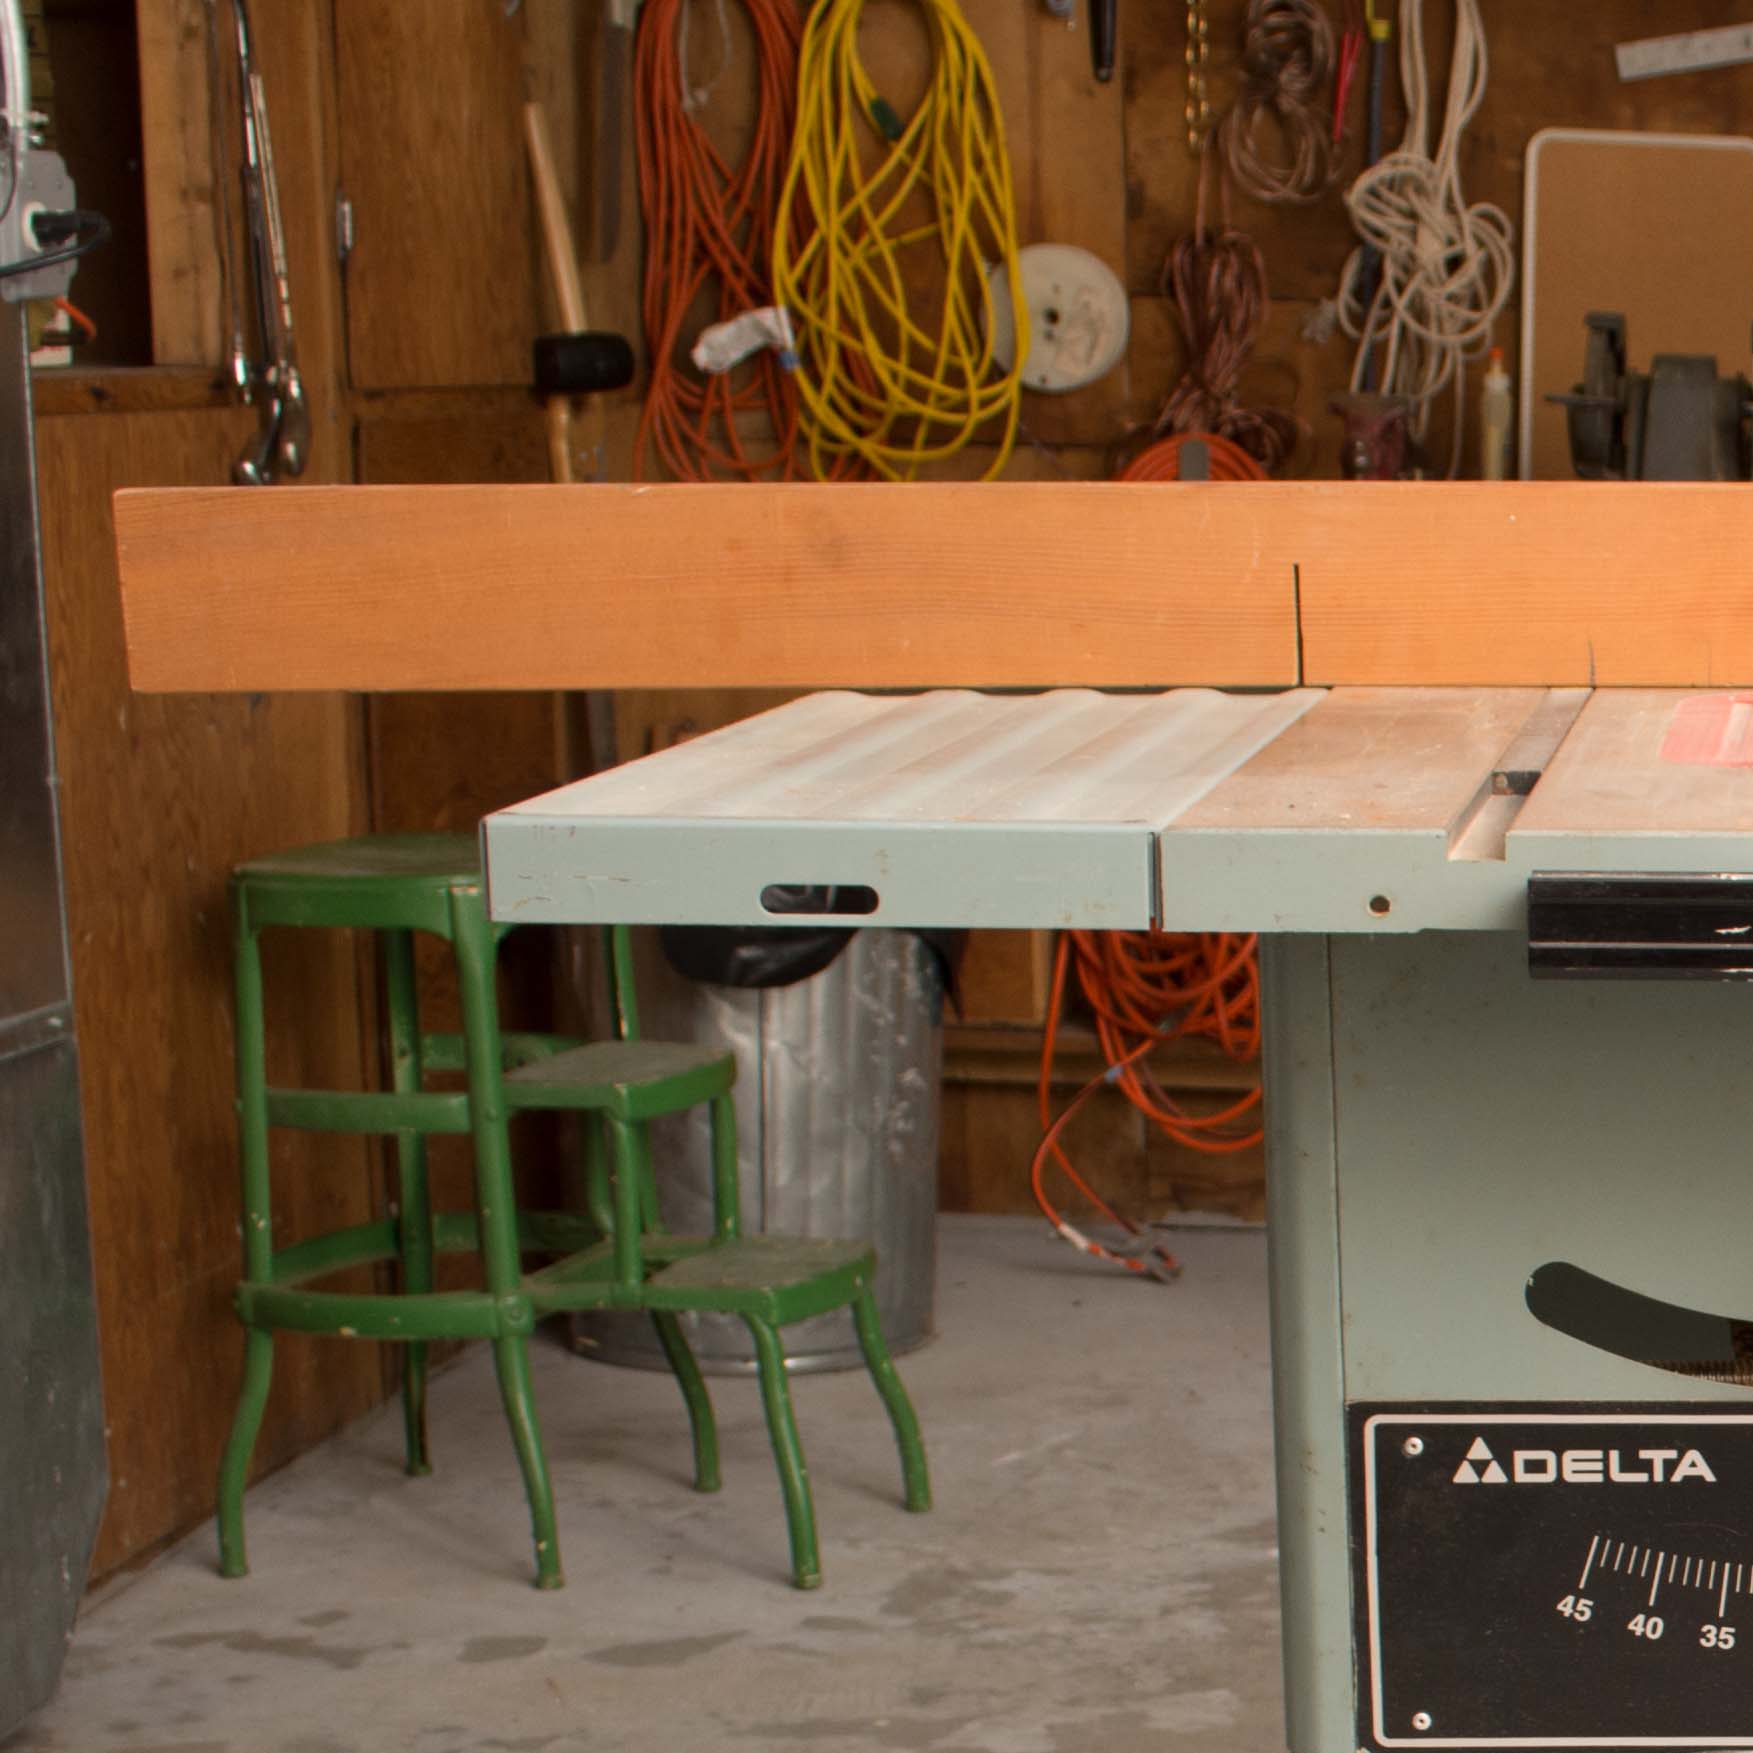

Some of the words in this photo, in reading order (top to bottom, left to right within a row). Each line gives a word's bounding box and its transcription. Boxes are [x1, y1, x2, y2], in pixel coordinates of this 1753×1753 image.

[1513, 1449, 1717, 1483] DELTA
[1556, 1595, 1594, 1622] 45
[1627, 1614, 1664, 1640] 40
[1700, 1625, 1736, 1650] 35
